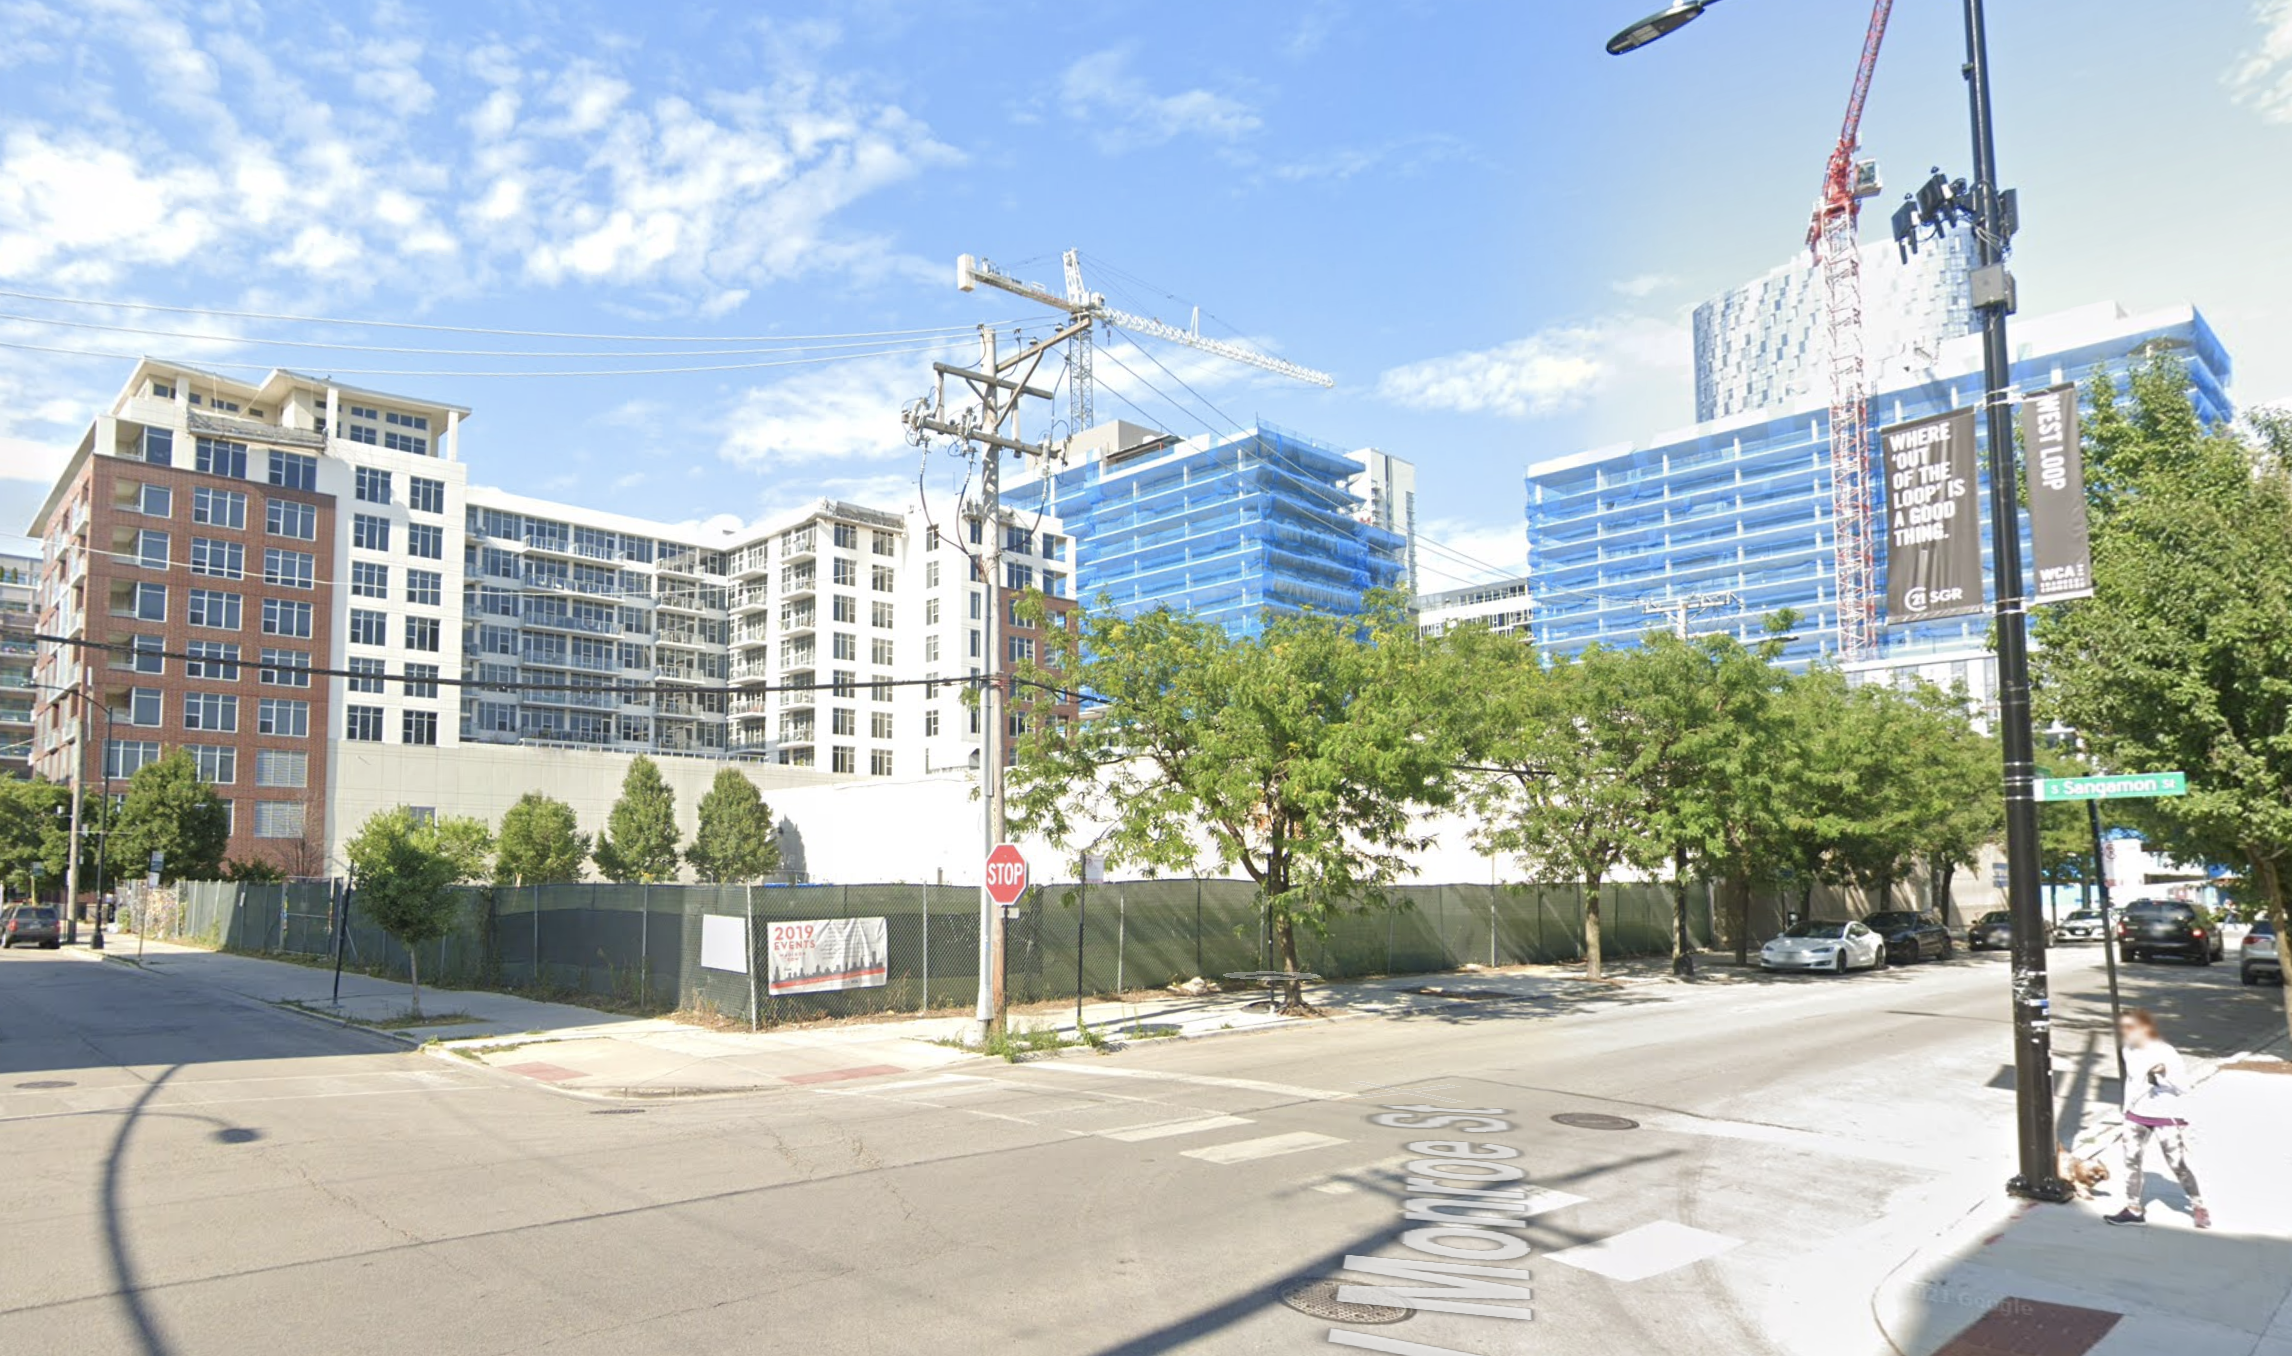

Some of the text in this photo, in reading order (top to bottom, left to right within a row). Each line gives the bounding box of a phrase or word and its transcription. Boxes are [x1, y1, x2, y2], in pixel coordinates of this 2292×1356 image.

[1890, 422, 1951, 451] WHERE
[2036, 393, 2067, 490] WEST LOOP
[1892, 461, 1951, 490] OF THE
[1947, 478, 1966, 498] IS
[1893, 500, 1956, 529] A GOOD
[1893, 521, 1950, 547] THING.
[2039, 565, 2075, 581] WCA
[1929, 587, 1963, 603] SGR
[2051, 778, 2176, 798] S Sangamon St
[987, 863, 1023, 885] STOP
[775, 925, 814, 940] 2019
[775, 940, 816, 950] EVENTS
